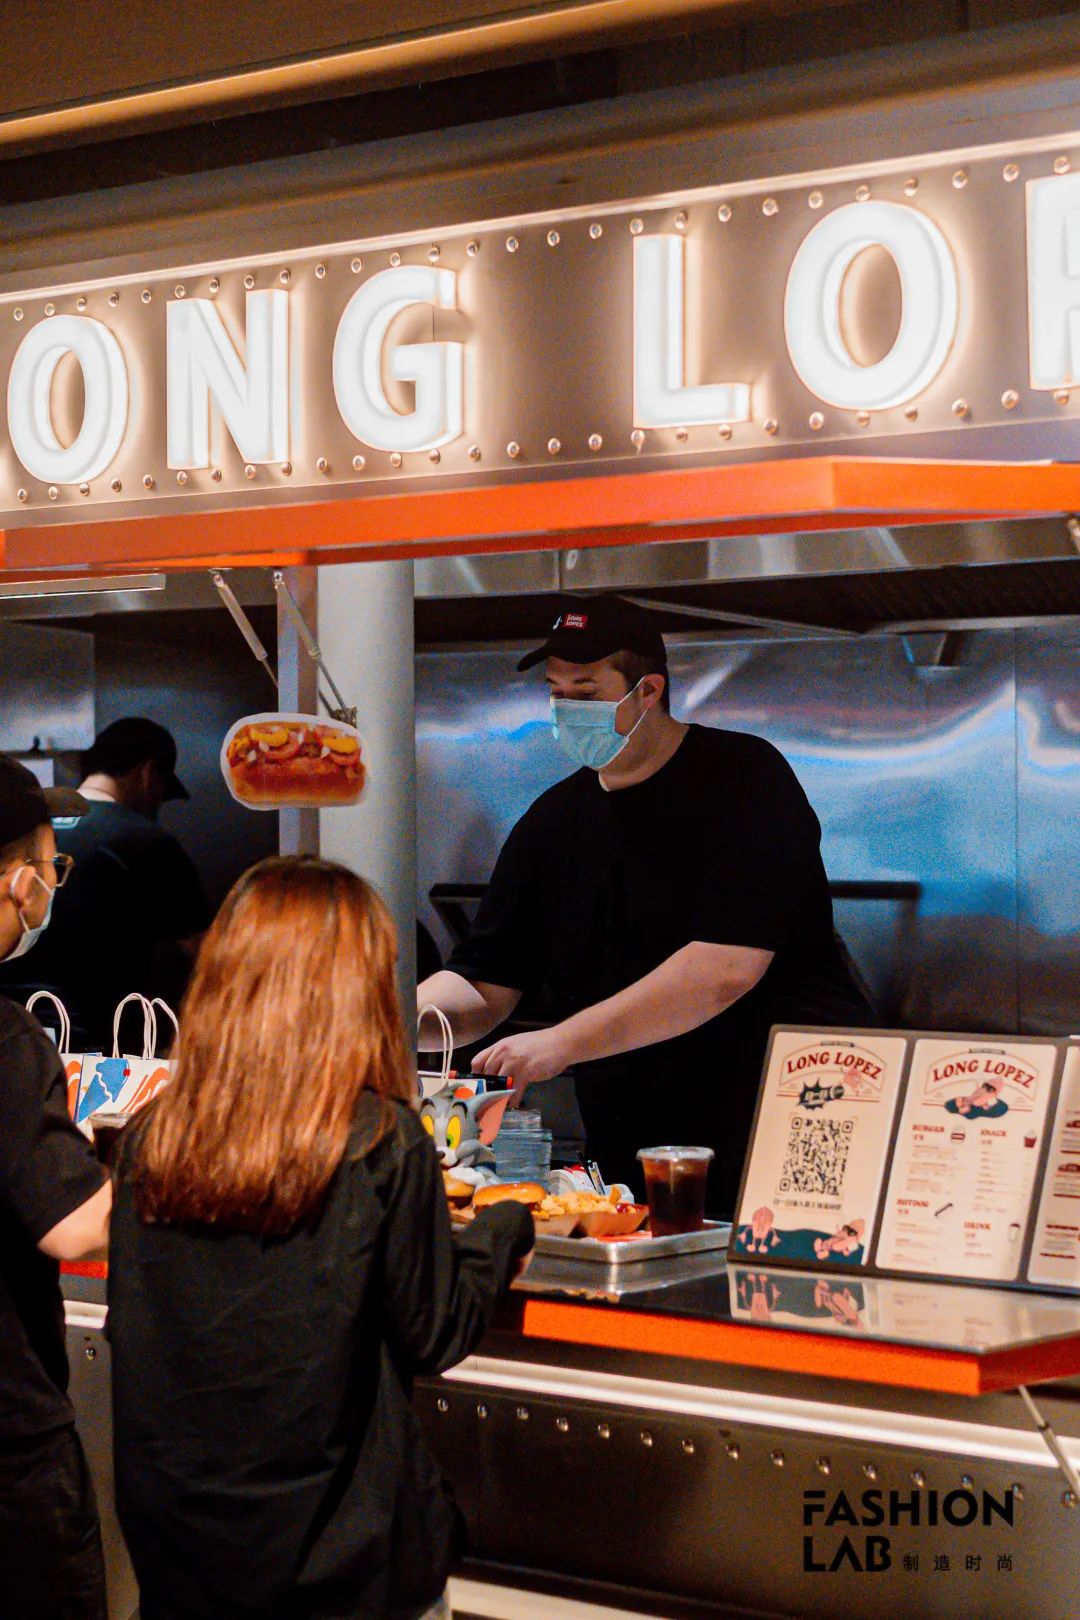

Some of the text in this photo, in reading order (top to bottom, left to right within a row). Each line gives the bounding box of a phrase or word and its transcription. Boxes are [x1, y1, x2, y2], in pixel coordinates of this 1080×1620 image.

[786, 1051, 883, 1080] LONG LOPEZ
[932, 1059, 1035, 1088] LONG LOPEZ
